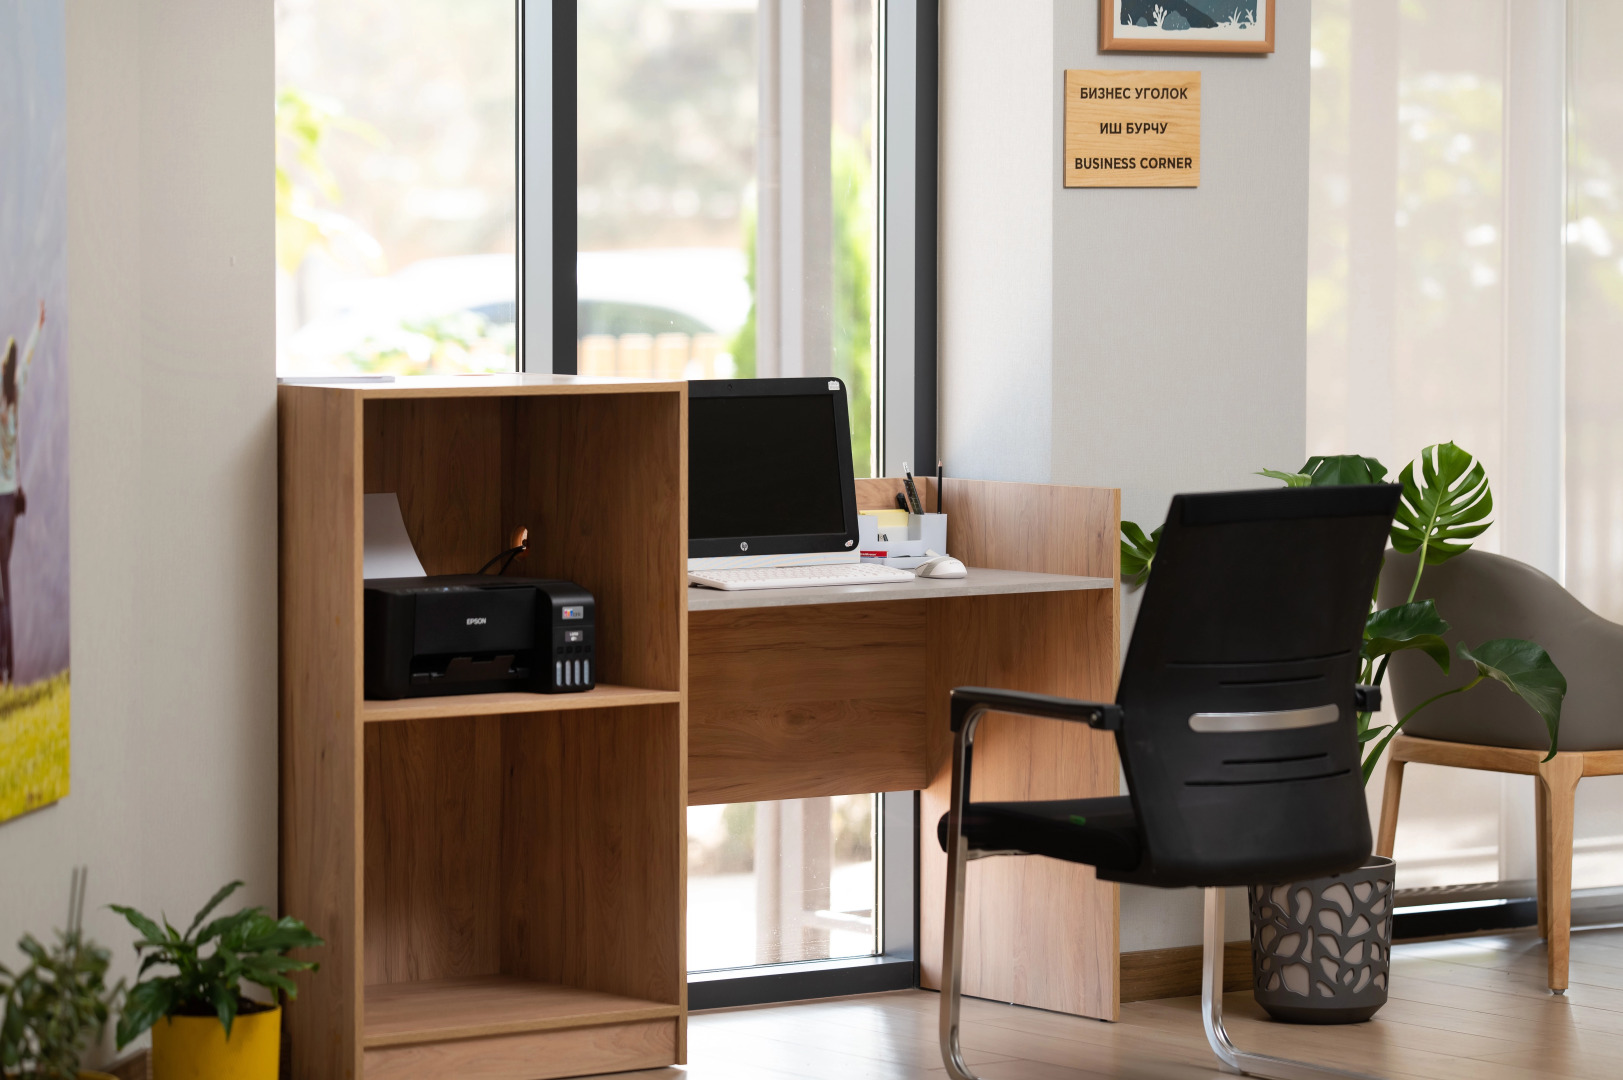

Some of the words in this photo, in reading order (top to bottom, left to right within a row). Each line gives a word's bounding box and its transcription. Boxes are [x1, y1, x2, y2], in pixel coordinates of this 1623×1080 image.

[1080, 87, 1131, 100] БИЗНЕС
[1135, 87, 1188, 100] УГОЛОК
[1100, 122, 1122, 134] ИШ
[1126, 122, 1168, 134] БУРЧУ
[1075, 157, 1136, 169] BUSINESS
[1140, 157, 1193, 169] CORNER
[466, 617, 487, 626] EPSON
